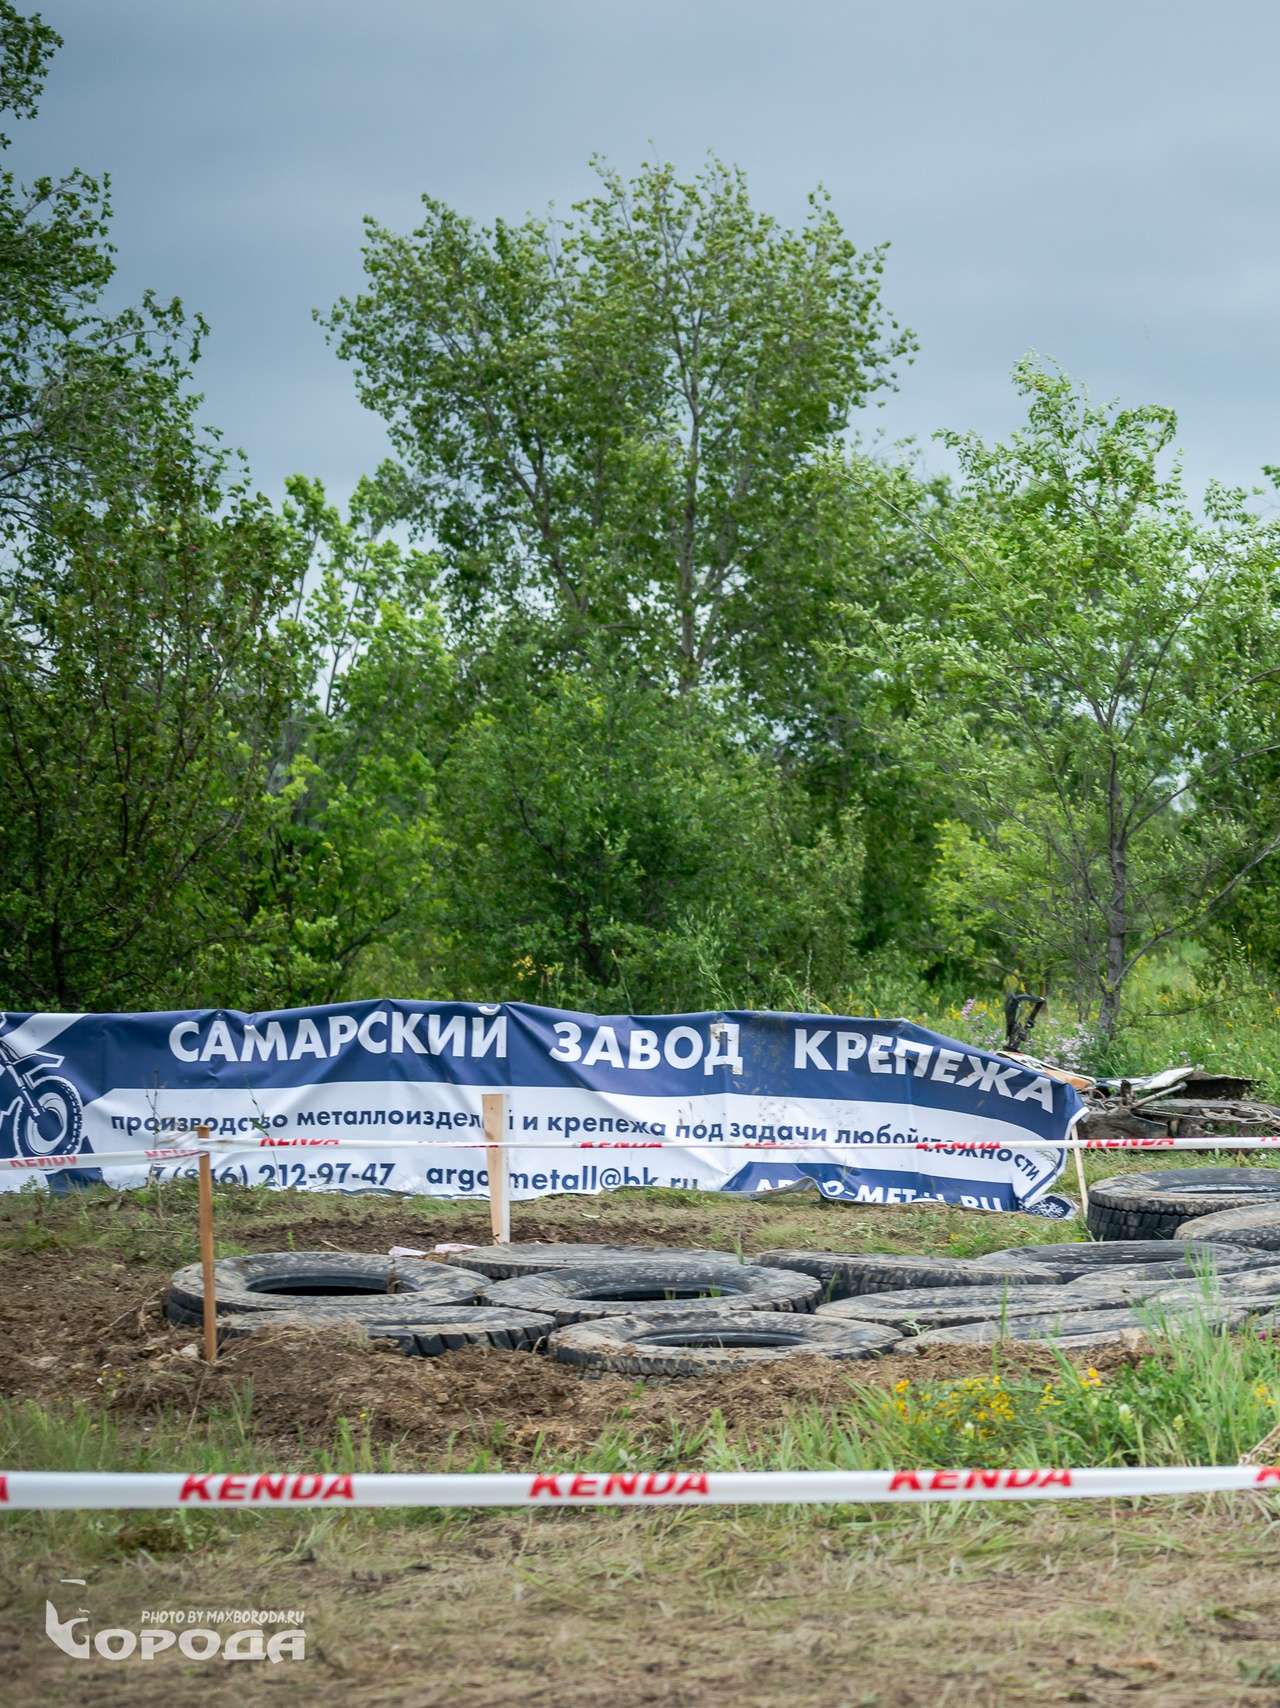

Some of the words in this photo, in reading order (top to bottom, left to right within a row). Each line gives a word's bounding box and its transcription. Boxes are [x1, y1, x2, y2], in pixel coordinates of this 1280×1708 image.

[168, 1004, 508, 1062] САМАРСКИЙ
[549, 1021, 743, 1076] ЗАВОД
[794, 1028, 1054, 1113] КРЕПЕЖА
[296, 1109, 513, 1130] металлоиздел
[523, 1116, 538, 1131] и
[548, 1115, 666, 1138] крепежа
[675, 1122, 724, 1142] под
[730, 1122, 827, 1143] задачи
[835, 1123, 919, 1144] любой
[258, 1162, 396, 1187] 212-97-47
[426, 1165, 698, 1192] argometall@bkru
[179, 1474, 355, 1502] KENDA
[529, 1473, 709, 1498] KENDA
[888, 1469, 1073, 1491] KENDA
